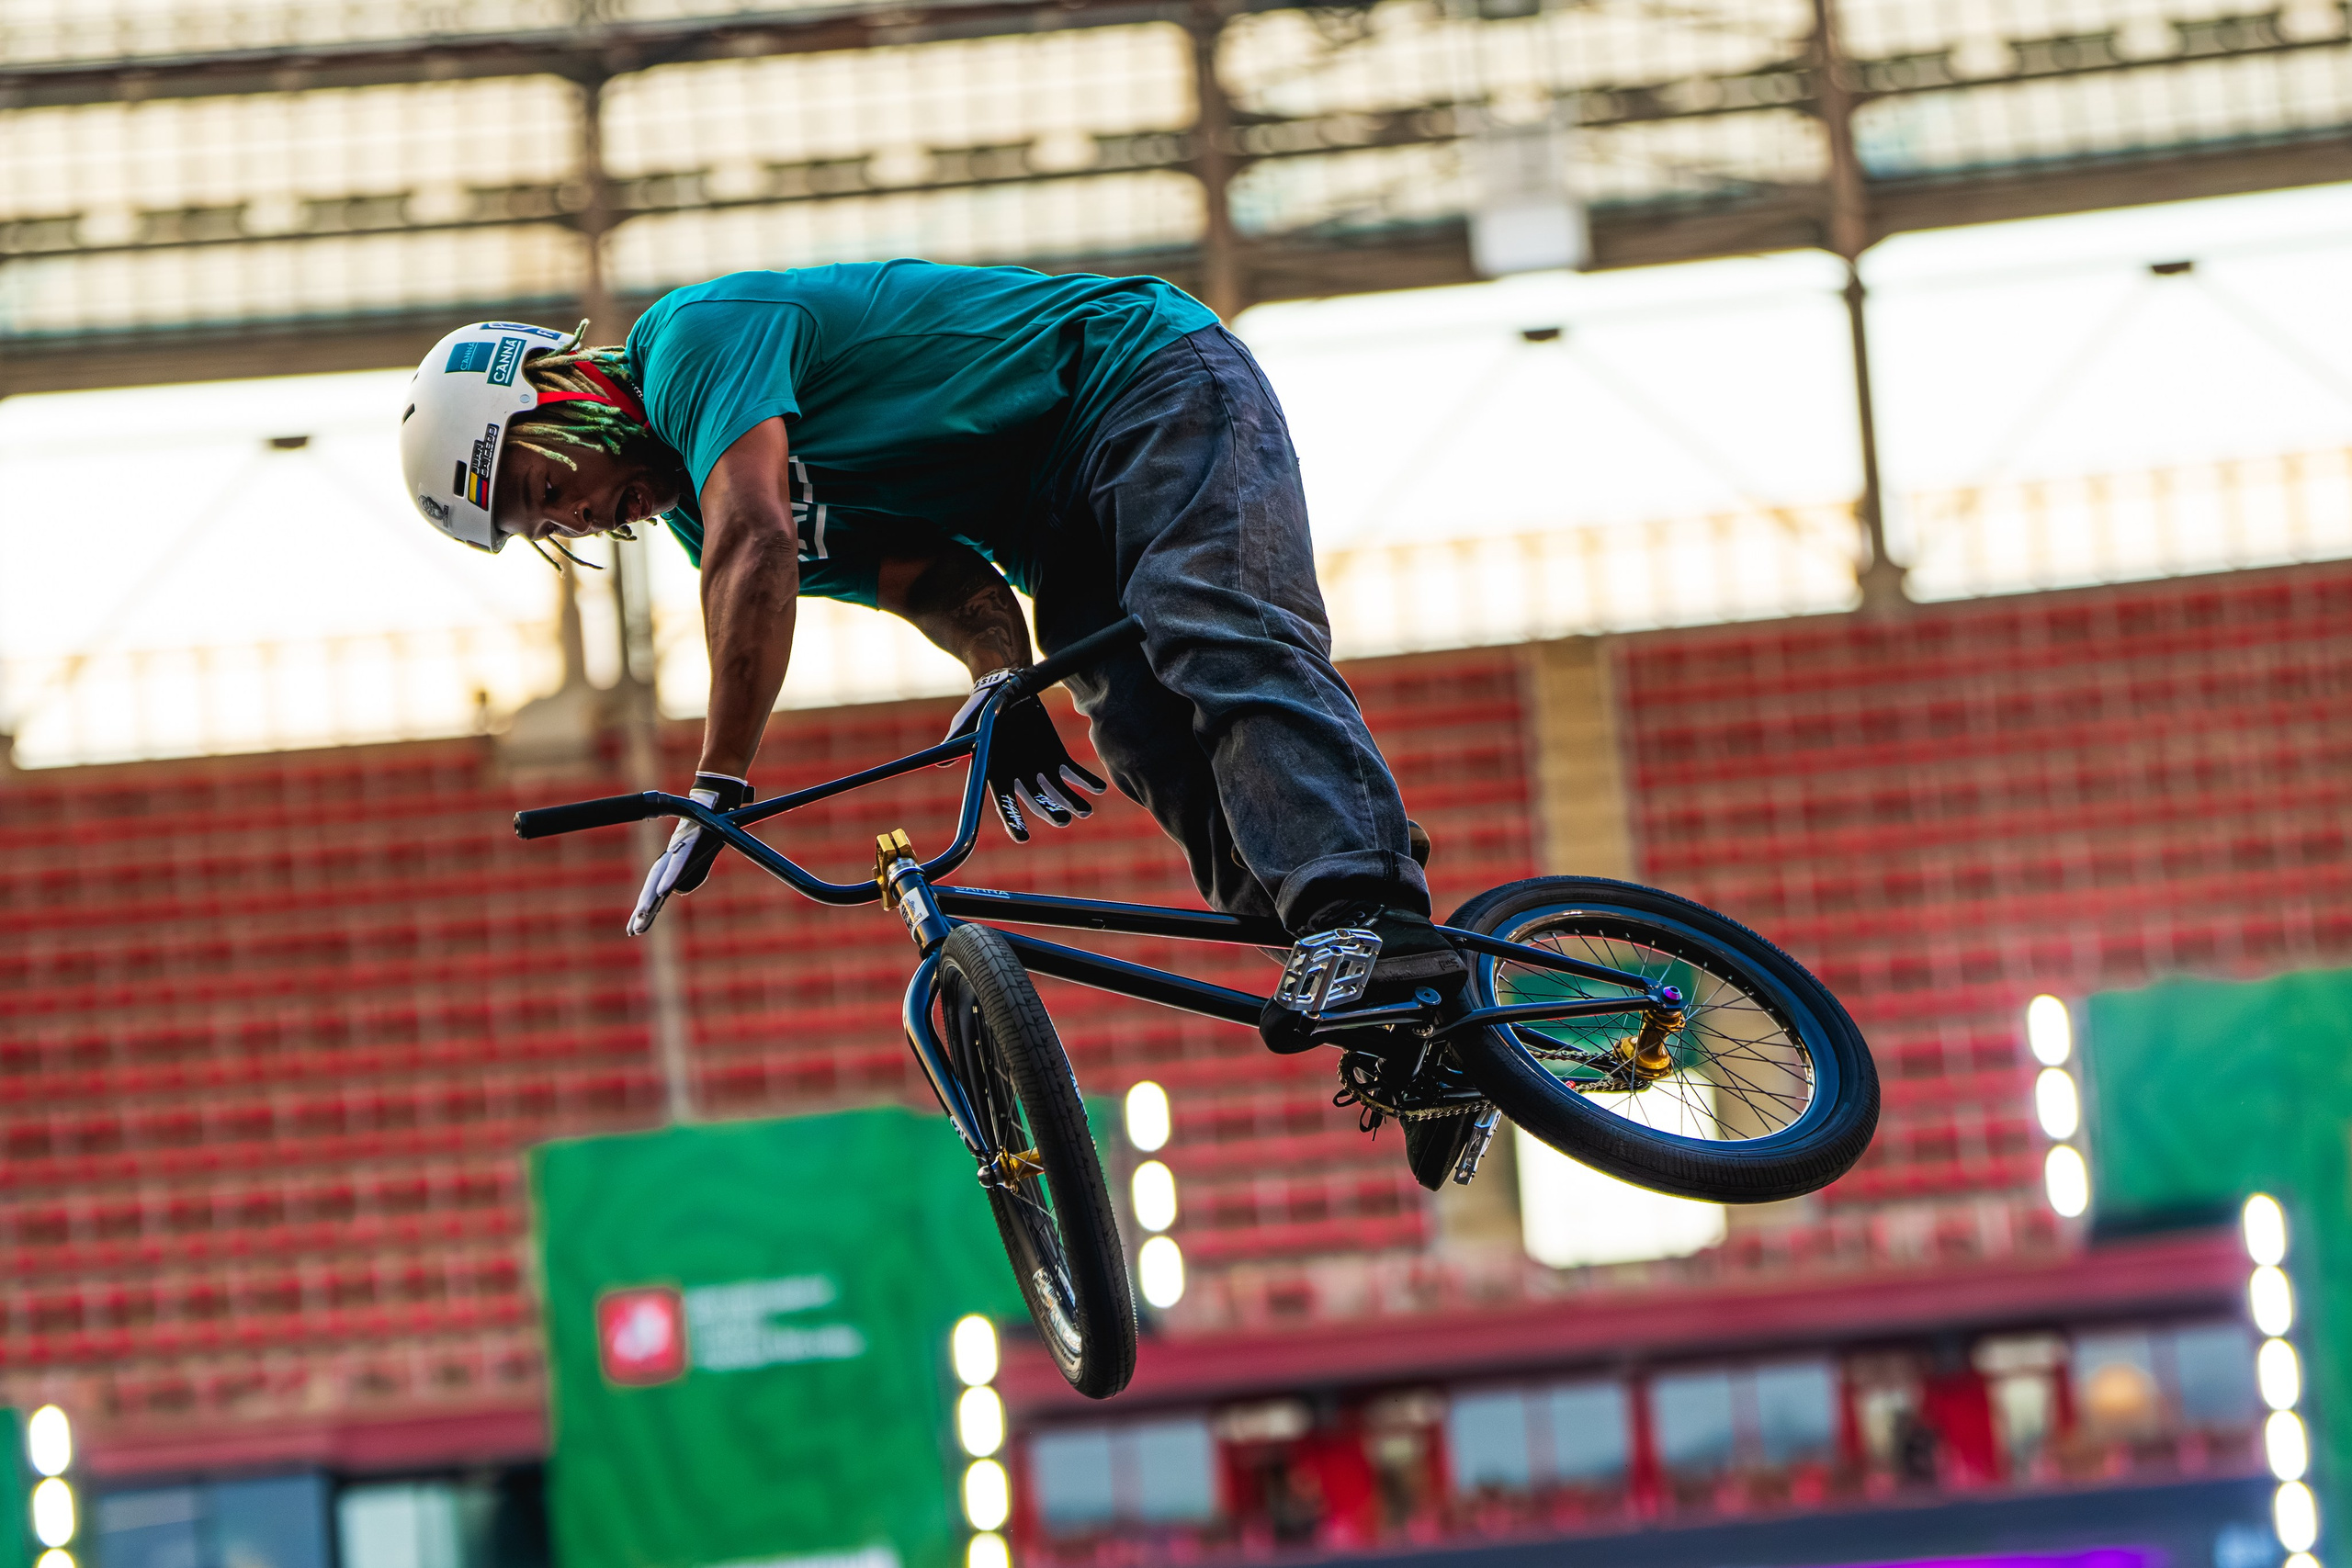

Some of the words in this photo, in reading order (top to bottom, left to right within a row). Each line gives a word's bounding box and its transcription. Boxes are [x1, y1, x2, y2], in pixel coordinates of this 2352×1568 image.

[460, 342, 476, 370] CANNA
[493, 339, 518, 382] CANNA
[472, 443, 484, 474] JUAN
[481, 425, 497, 478] CAICEDO
[973, 673, 1001, 689] FIST
